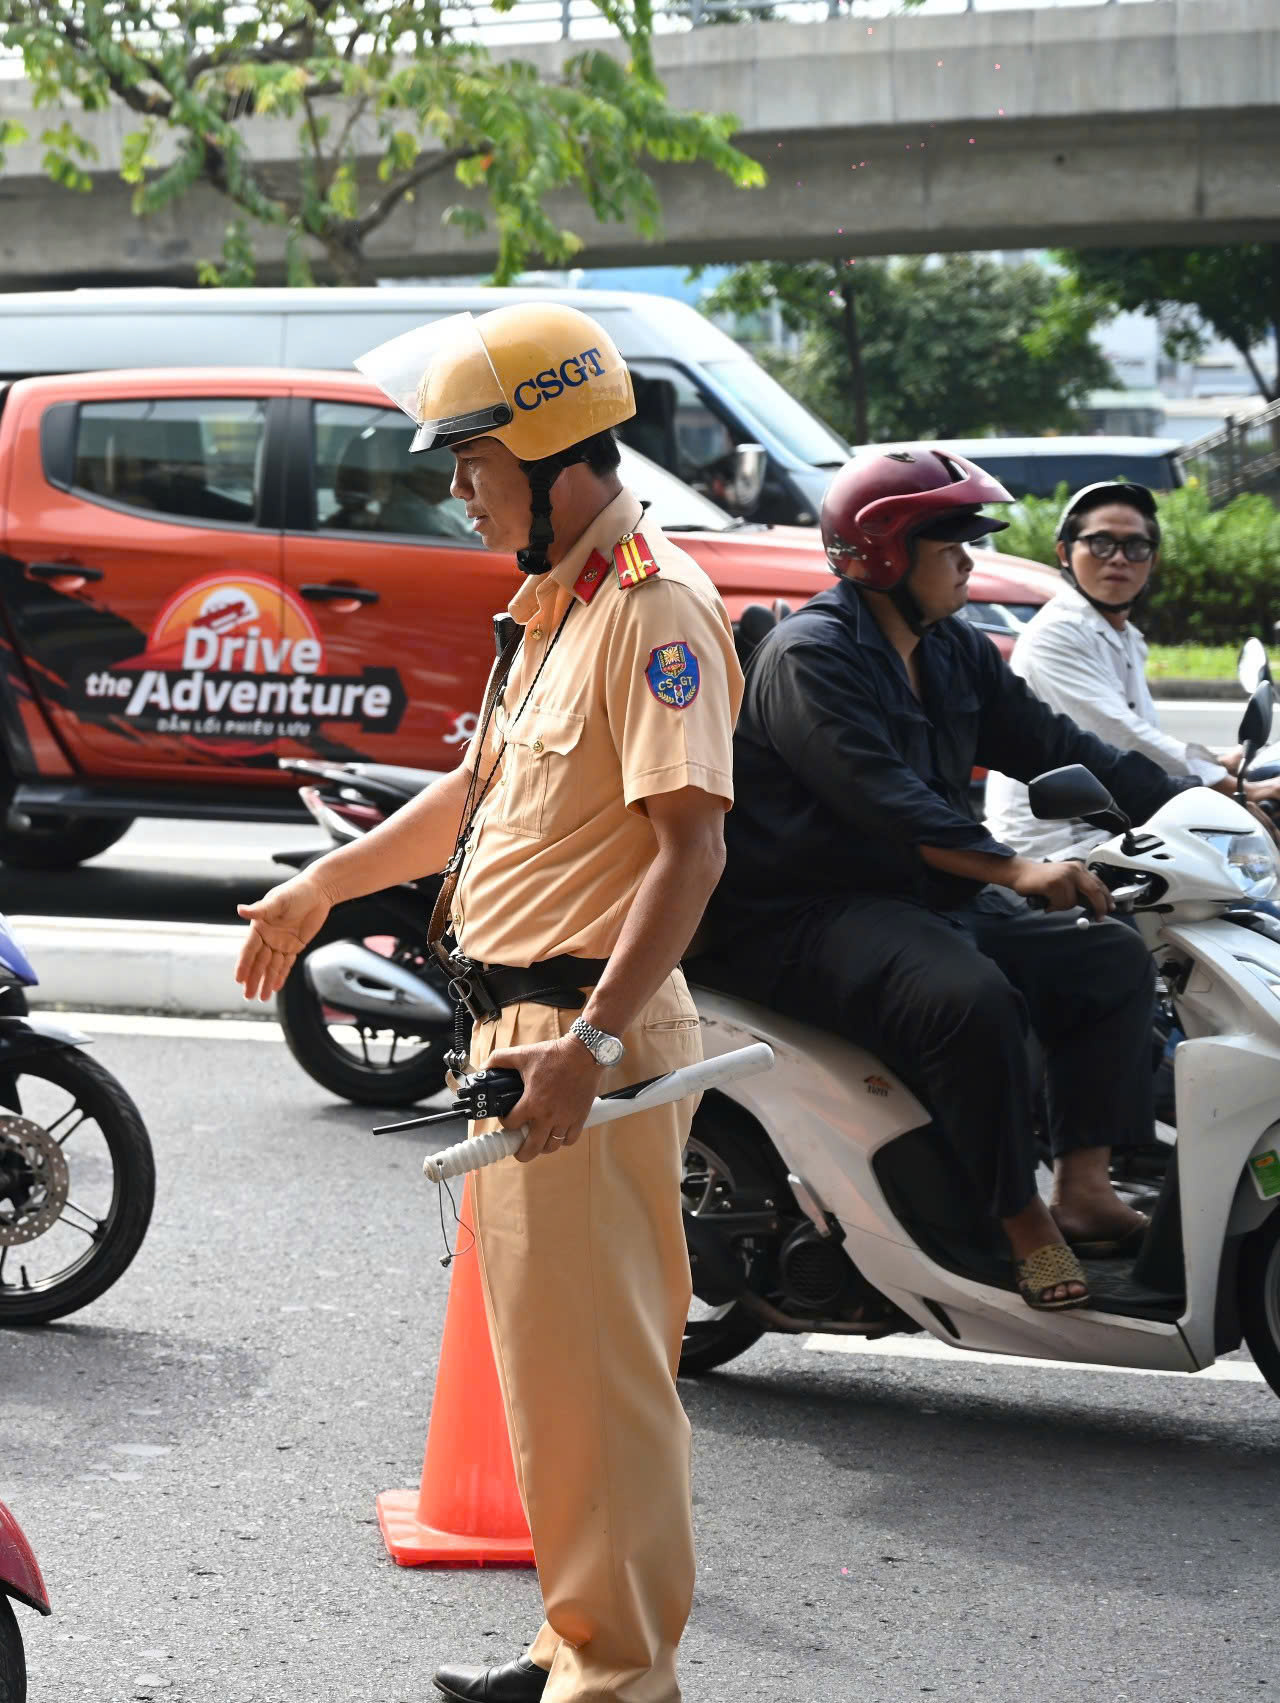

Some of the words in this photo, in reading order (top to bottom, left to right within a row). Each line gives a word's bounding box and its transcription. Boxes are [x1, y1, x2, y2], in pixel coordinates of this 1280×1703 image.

[514, 348, 606, 411] CSGT
[182, 626, 322, 673] Drive
[86, 671, 132, 698] the
[125, 670, 391, 717] Adventure
